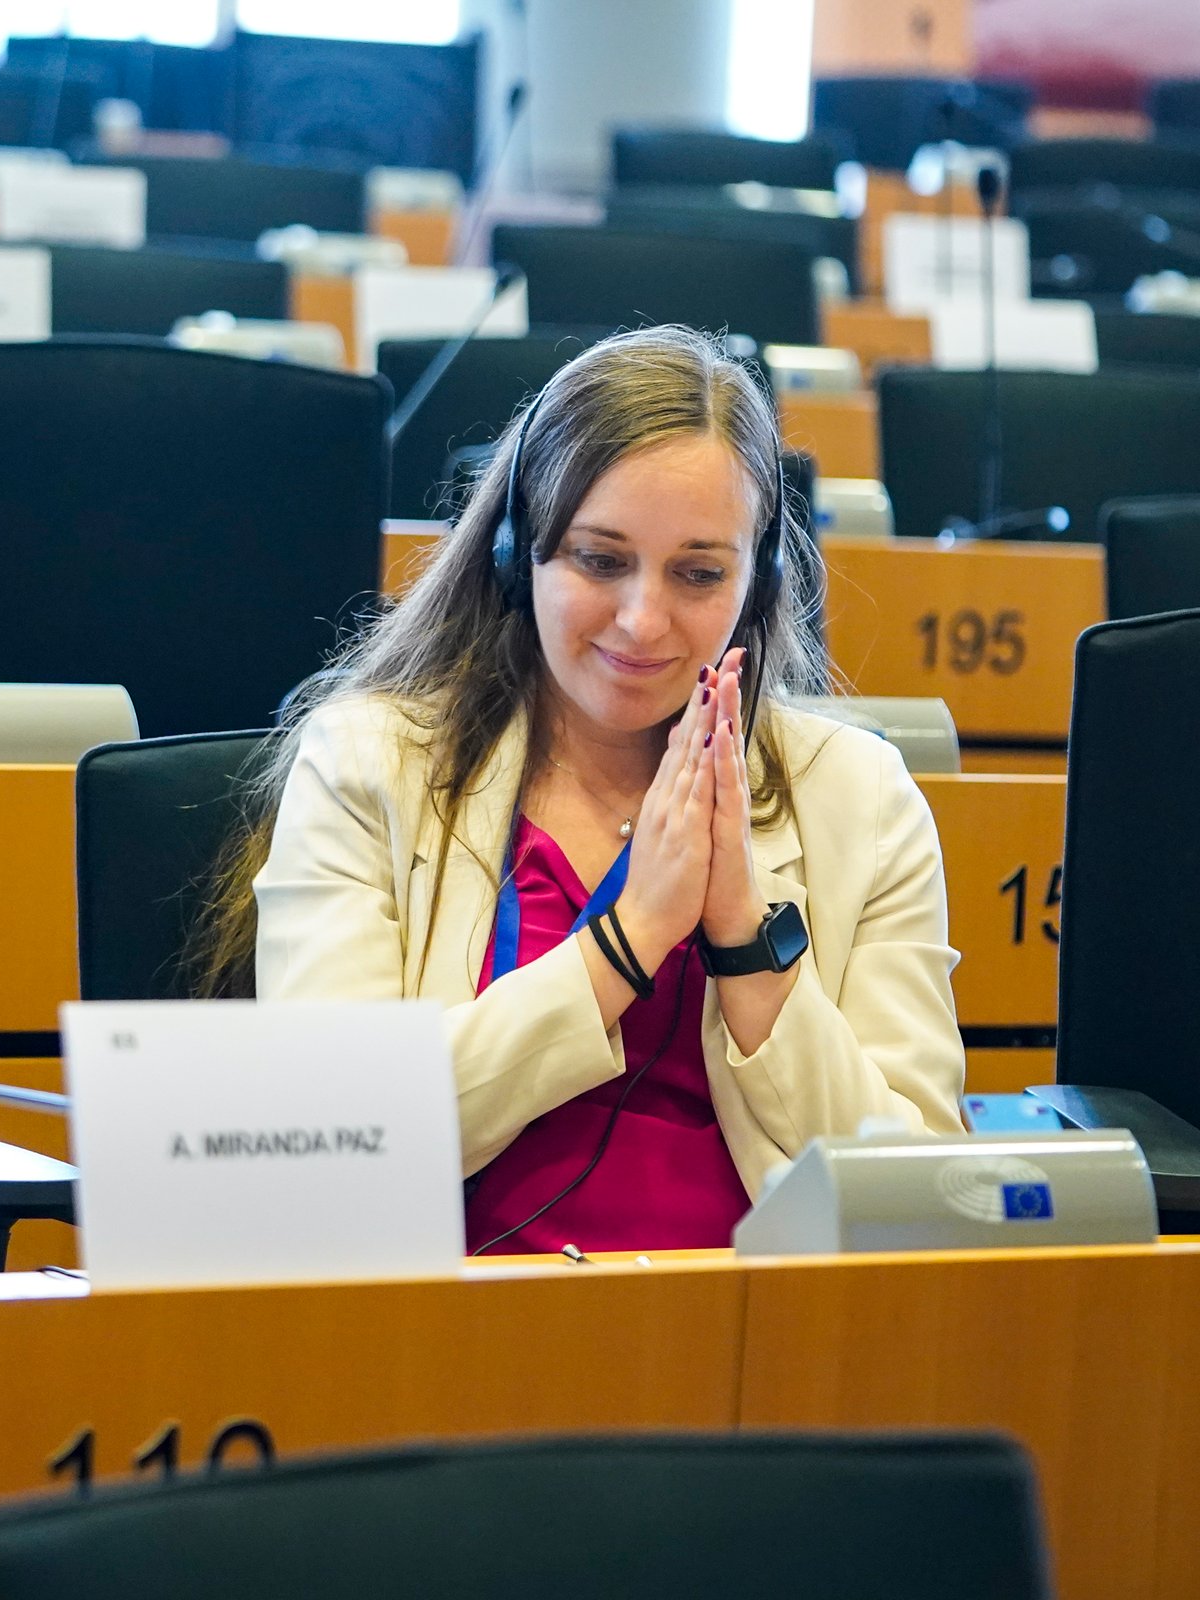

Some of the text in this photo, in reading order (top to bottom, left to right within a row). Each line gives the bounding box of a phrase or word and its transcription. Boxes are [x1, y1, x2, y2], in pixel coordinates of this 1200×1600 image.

[917, 609, 1025, 675] 195
[203, 1128, 331, 1157] MIRANDA
[335, 1125, 384, 1153] PAZ
